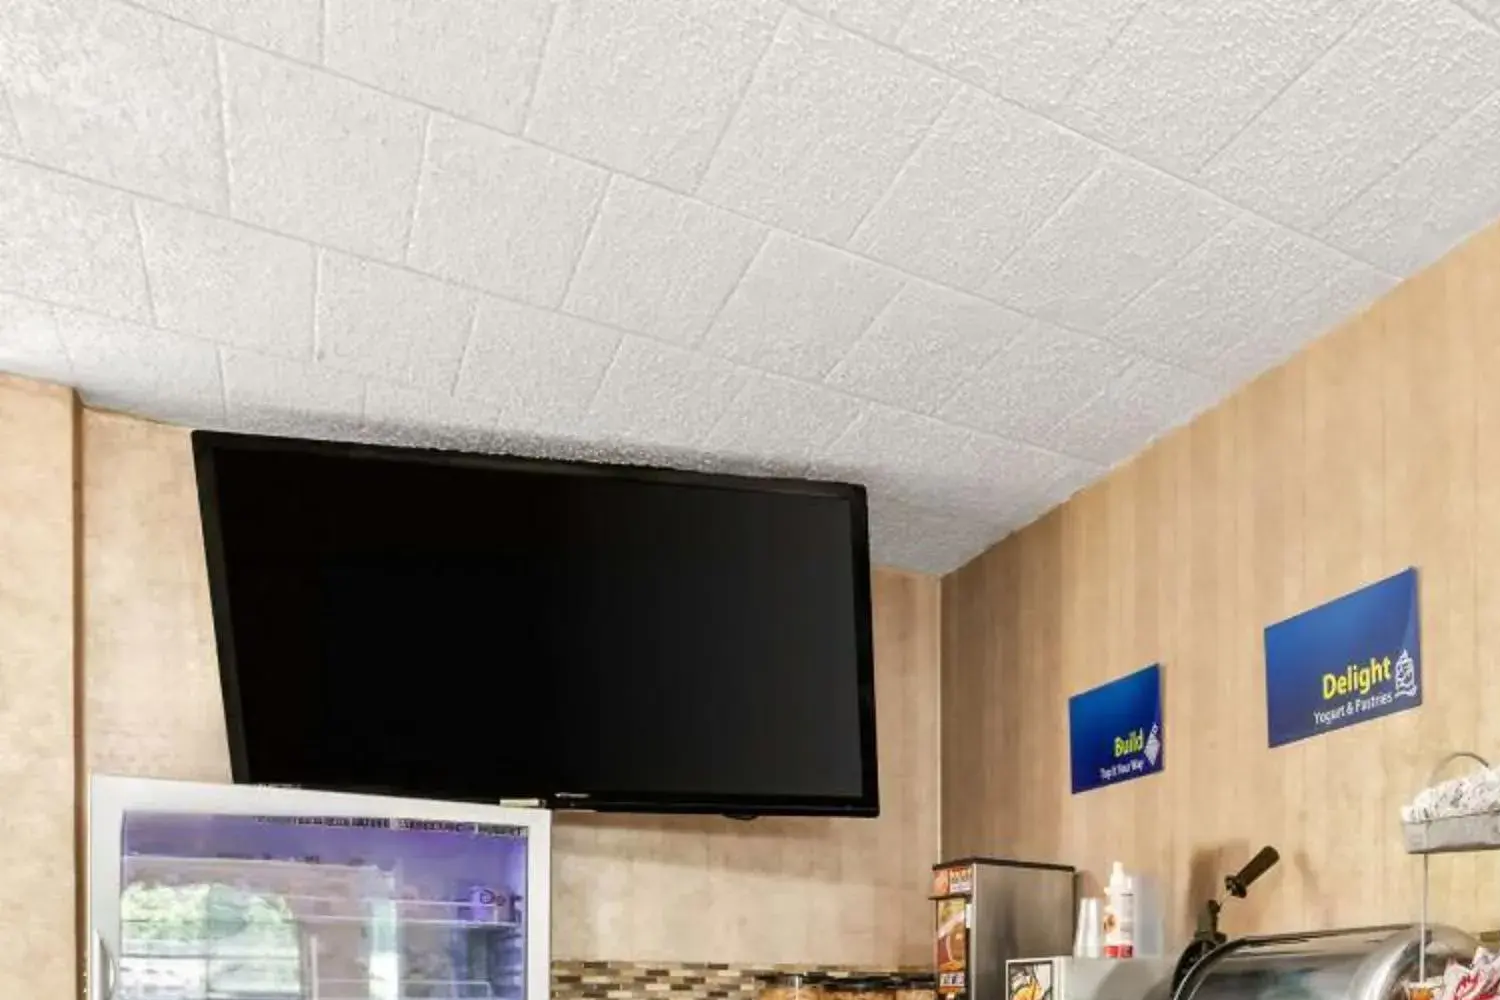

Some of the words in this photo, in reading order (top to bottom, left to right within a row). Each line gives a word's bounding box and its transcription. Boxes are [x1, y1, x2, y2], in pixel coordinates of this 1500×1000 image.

[1322, 655, 1392, 699] Delight
[1313, 705, 1345, 725] Yogurt
[1345, 701, 1354, 715] &
[1355, 692, 1393, 713] Pastries
[1114, 727, 1143, 758] Build
